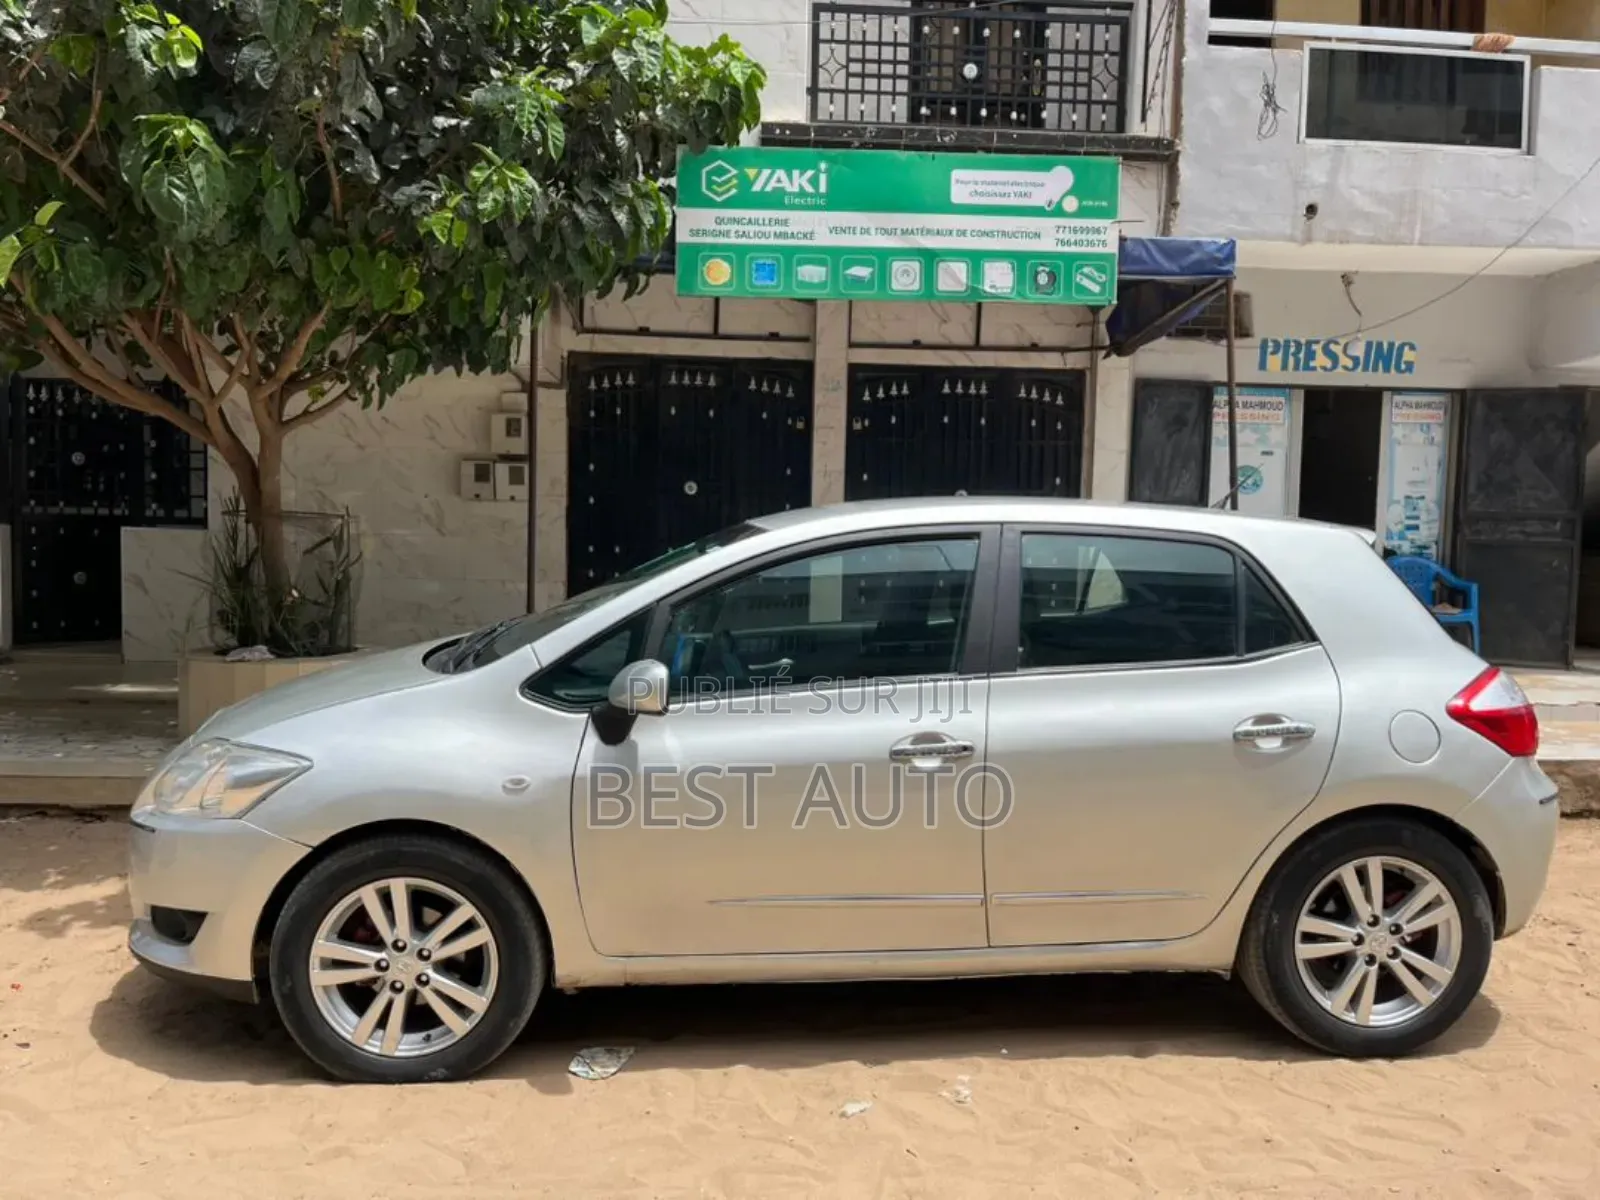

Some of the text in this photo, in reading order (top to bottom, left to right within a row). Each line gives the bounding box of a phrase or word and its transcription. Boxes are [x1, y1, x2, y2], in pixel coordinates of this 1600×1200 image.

[784, 195, 827, 206] Electric
[714, 216, 790, 227] QUINCAILLERIE
[688, 228, 817, 241] SERIGNE SALIOU MBACKÉ
[828, 225, 1041, 240] VENTE DE TOUT MATÉRIAUX DE CONSTRUCTION
[1258, 337, 1417, 375] PRESSING
[1241, 400, 1284, 411] MAHMOUD
